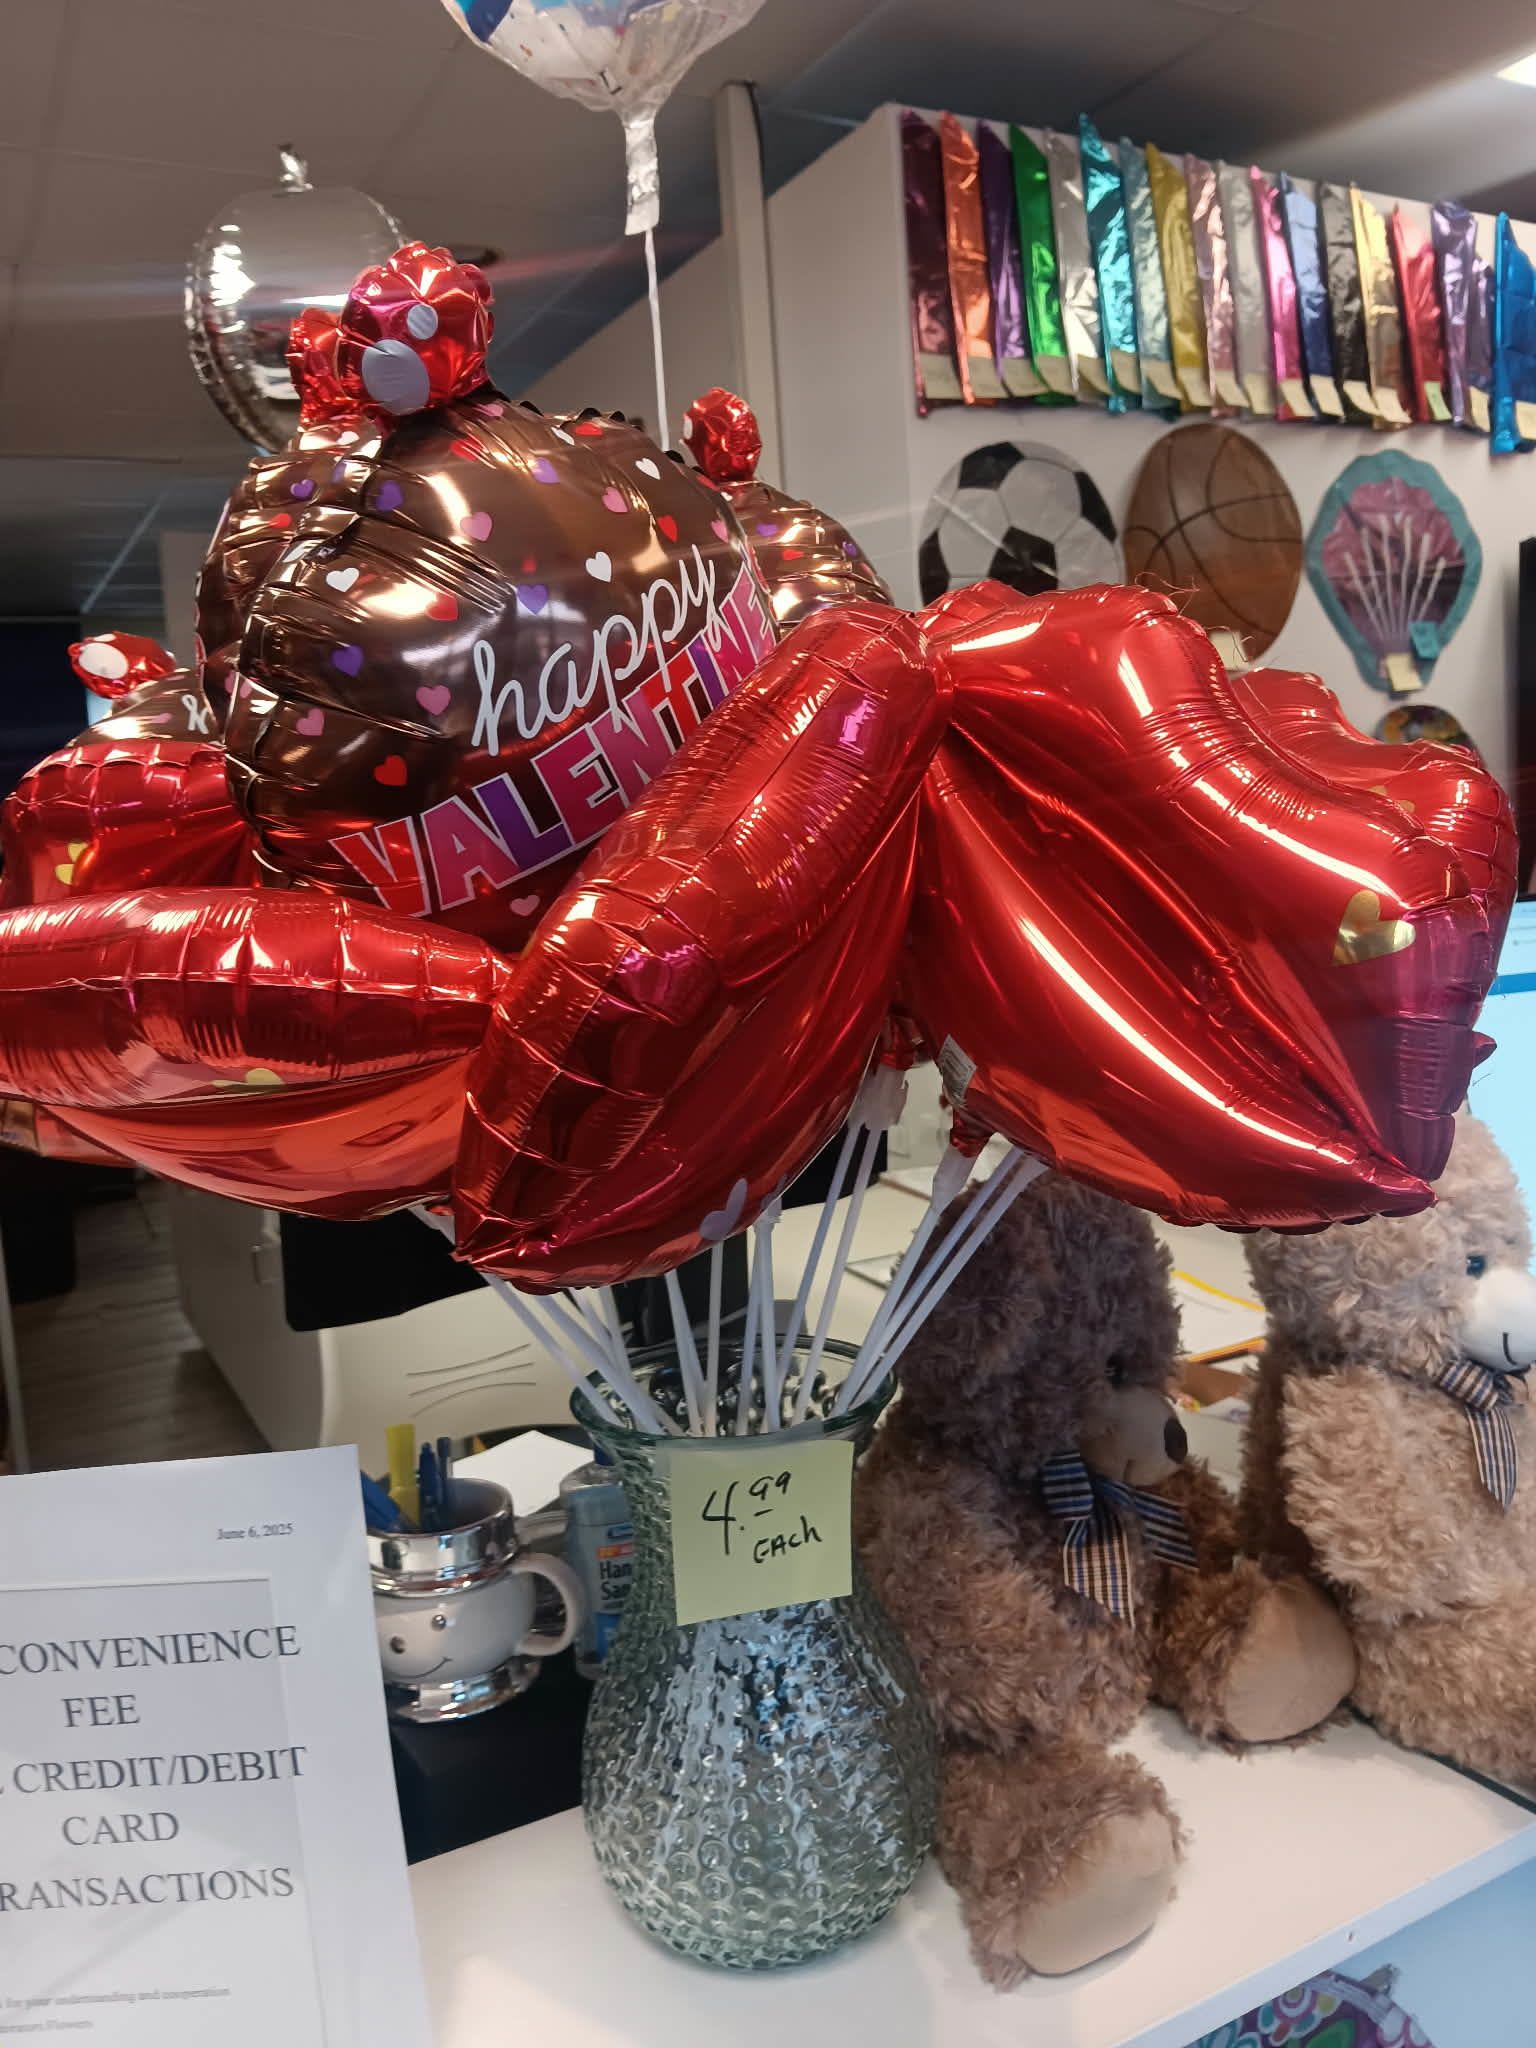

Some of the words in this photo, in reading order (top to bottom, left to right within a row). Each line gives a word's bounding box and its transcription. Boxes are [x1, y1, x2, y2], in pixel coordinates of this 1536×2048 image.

[471, 543, 730, 757] happy
[328, 541, 778, 919] VALENTINE
[216, 1527, 246, 1541] June
[263, 1522, 294, 1537] 2025
[62, 1694, 140, 1728] FEE
[13, 1747, 308, 1794] CREDIT/DEBIT
[63, 1812, 180, 1846] CARD
[0, 1867, 295, 1913] RANSACTIONS
